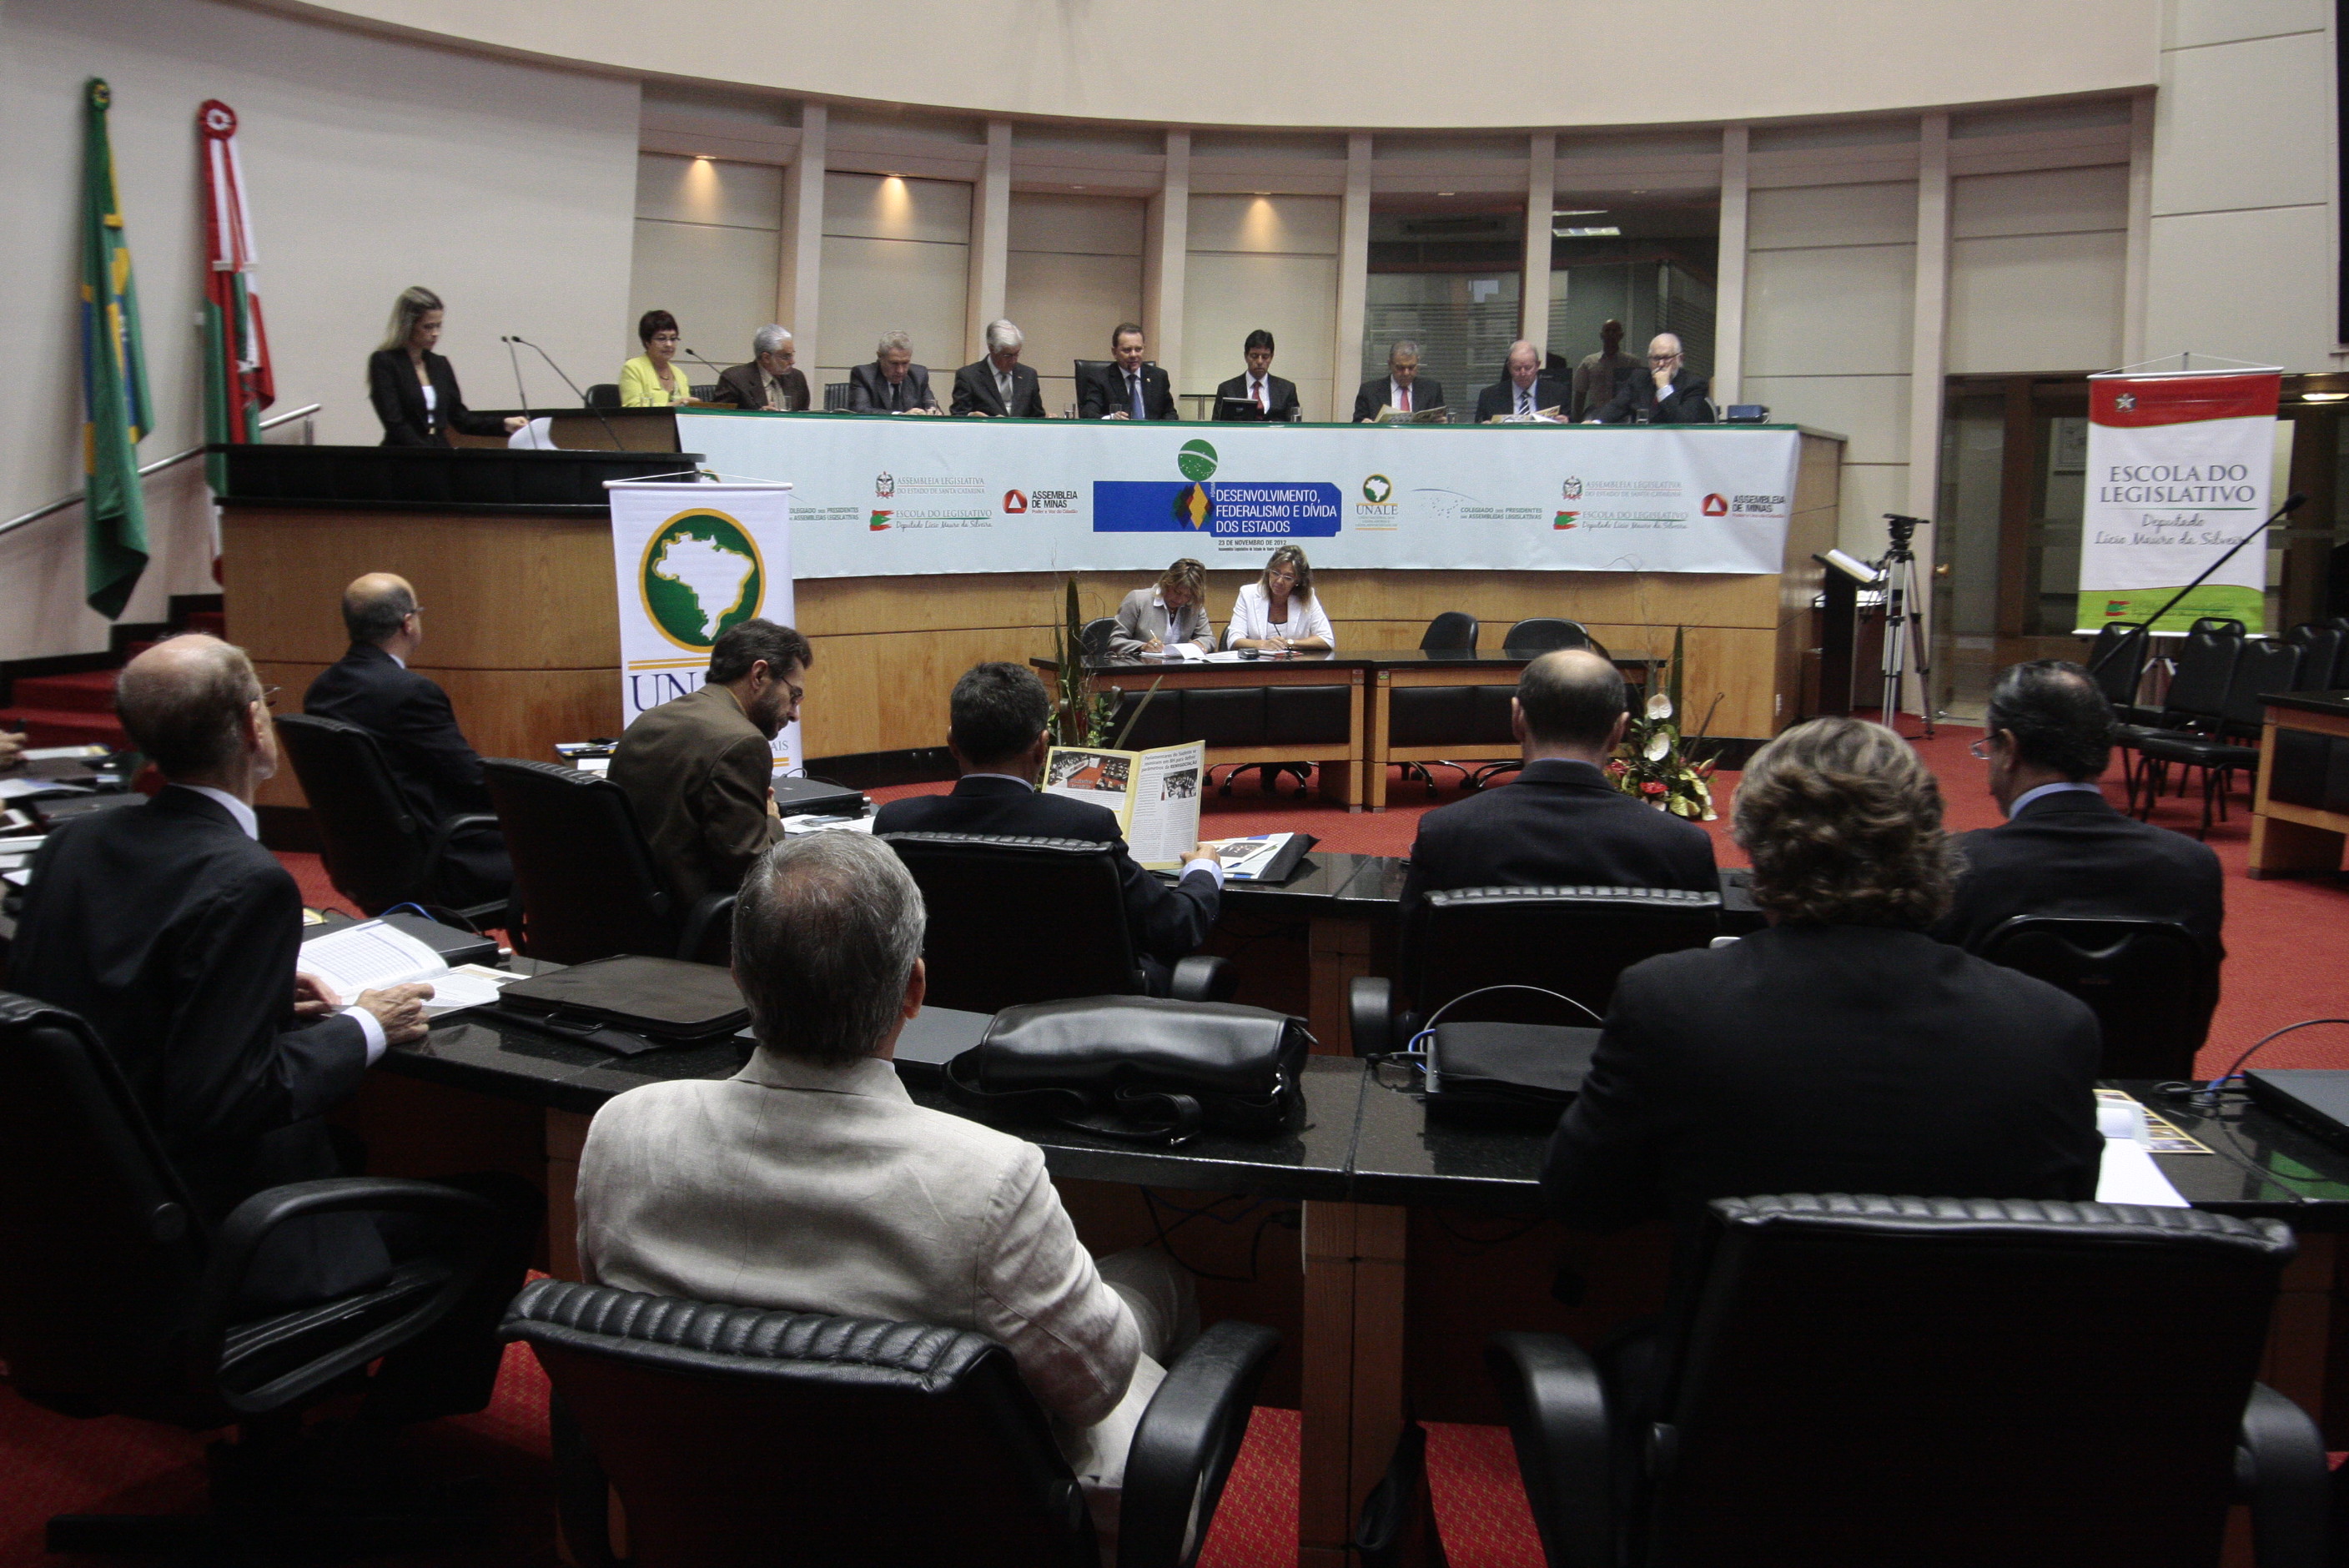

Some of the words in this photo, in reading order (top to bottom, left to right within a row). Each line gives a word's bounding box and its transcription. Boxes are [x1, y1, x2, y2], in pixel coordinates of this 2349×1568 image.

[2110, 465, 2201, 482] ESCOLA
[2208, 465, 2248, 481] DO
[898, 477, 938, 485] ASSEMBLEIA
[1032, 490, 1078, 500] ASSEMBLEIA
[1216, 490, 1320, 503] DESENVOLVIMENTO,
[1733, 495, 1785, 504] ASSEMBLEIA
[2100, 485, 2256, 502] LEGISLATIVO
[896, 510, 924, 518] ESCOLA
[1216, 505, 1290, 517] FEDERALISMO
[1293, 505, 1300, 517] E
[1302, 503, 1337, 517] DÍVIDA
[1356, 505, 1398, 515] UNALE
[1216, 520, 1239, 533] DOS
[1242, 520, 1290, 533] ESTADOS
[2142, 513, 2205, 534] Deputado
[629, 671, 697, 711] UN
[772, 741, 788, 751] AIS
